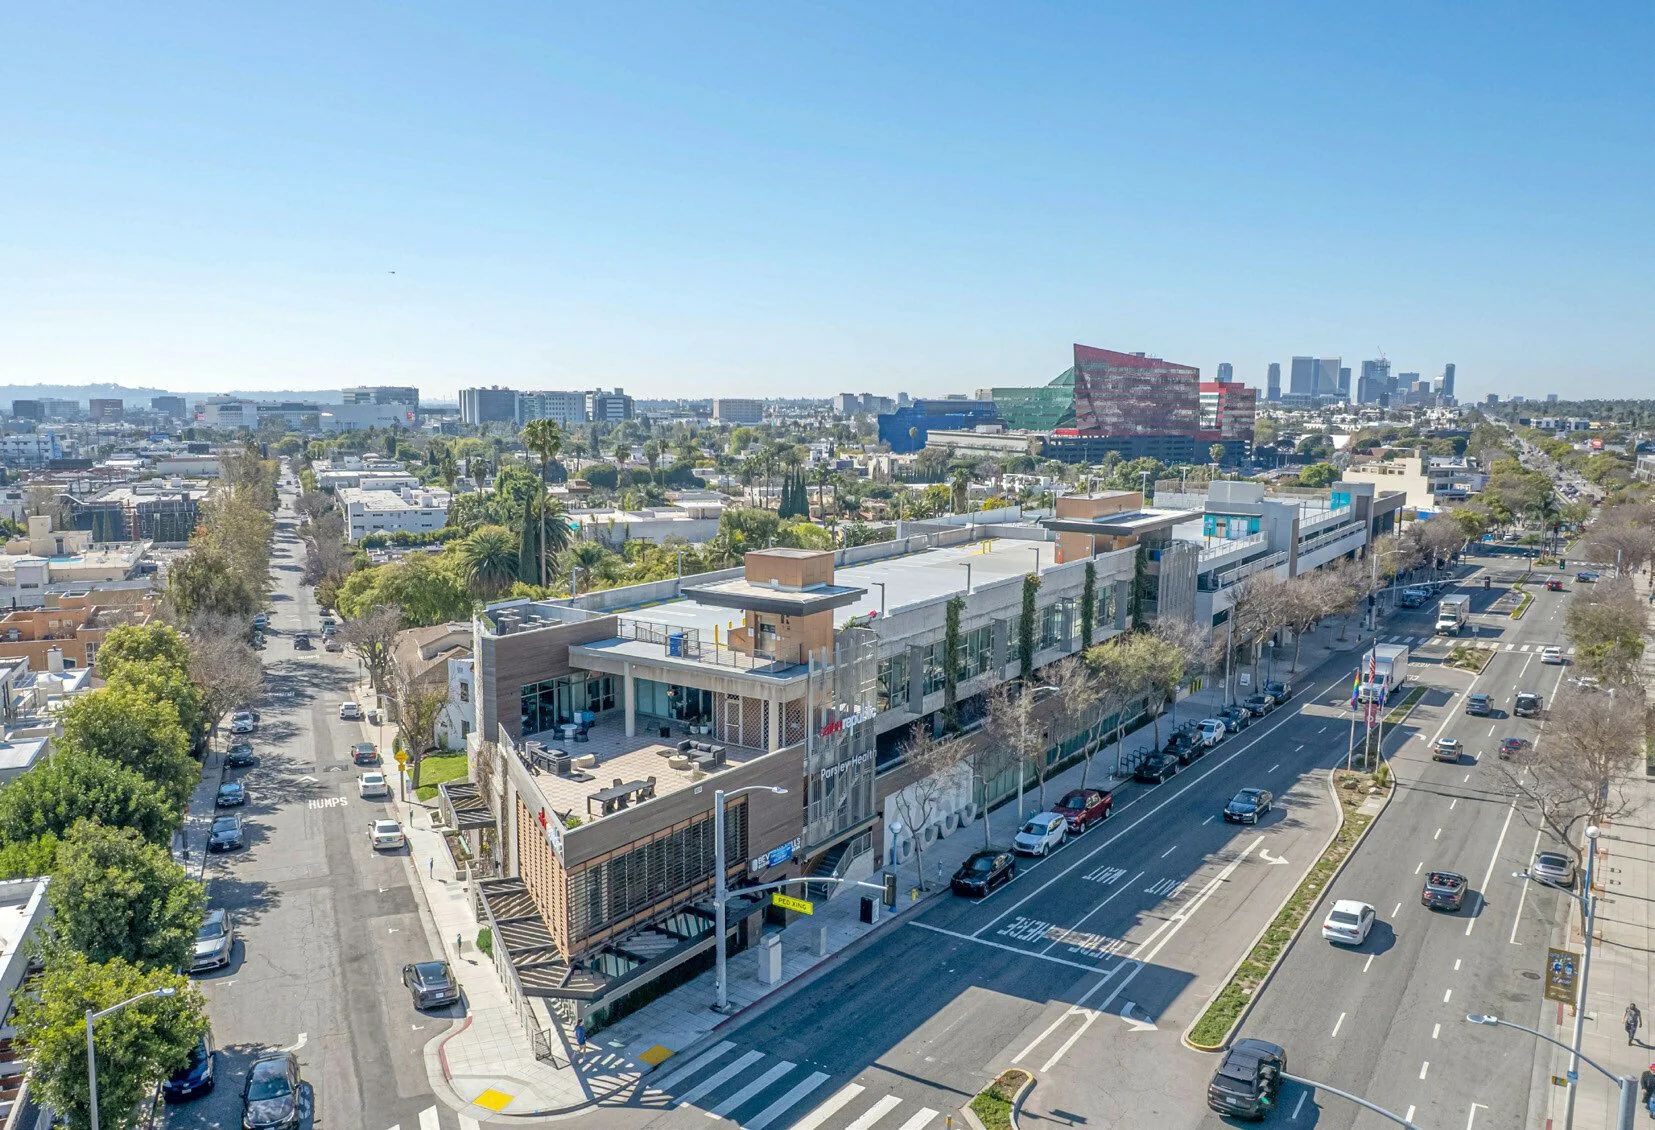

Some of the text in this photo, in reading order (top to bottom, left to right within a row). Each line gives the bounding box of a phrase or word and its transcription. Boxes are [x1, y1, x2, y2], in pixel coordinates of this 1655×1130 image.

[821, 748, 877, 780] Parsley Health
[308, 797, 348, 810] HUMPS
[1082, 866, 1127, 884] WAIT
[778, 897, 807, 910] PED XING
[997, 916, 1056, 942] HERE
